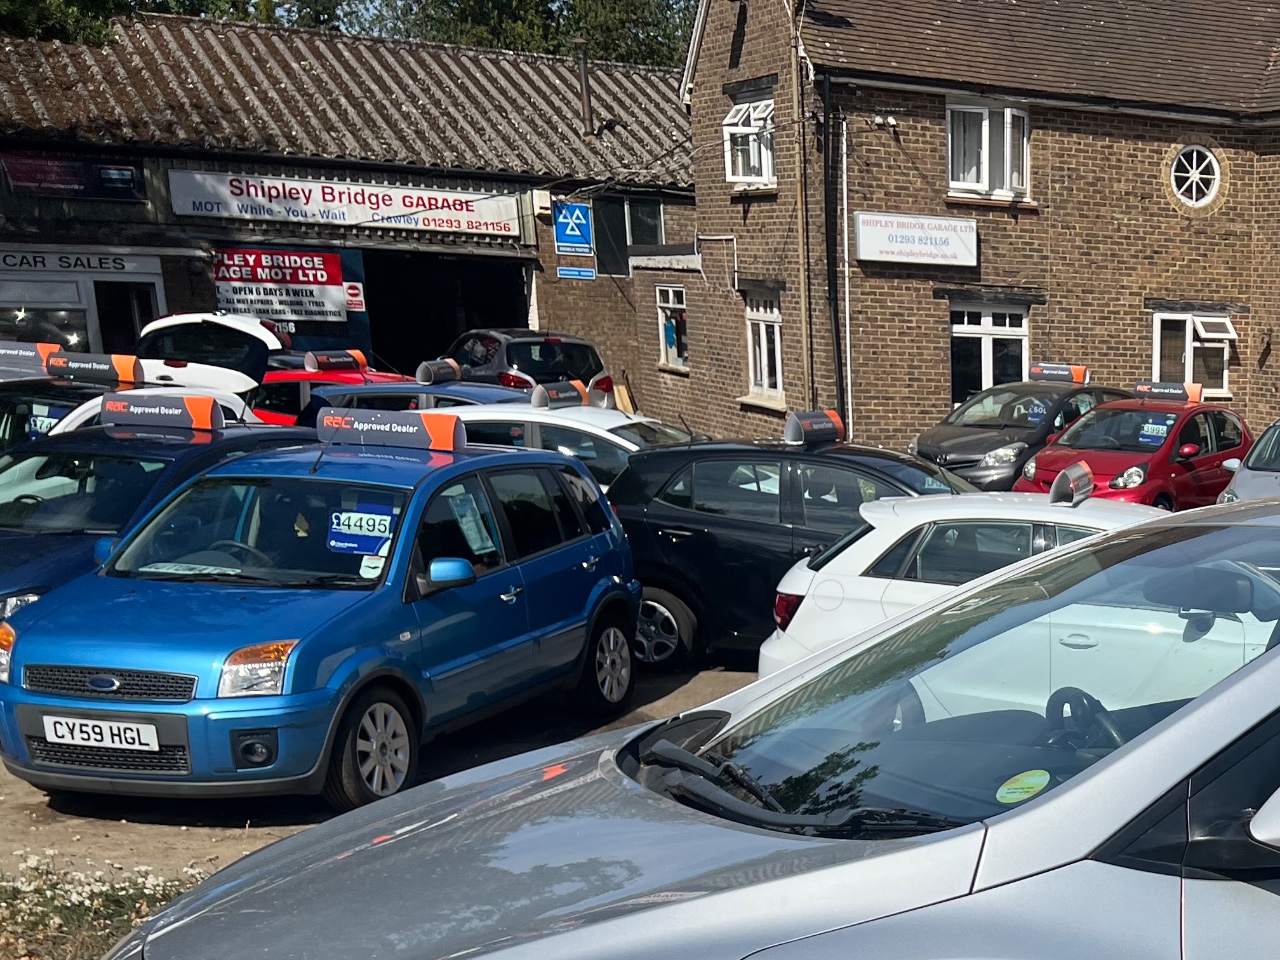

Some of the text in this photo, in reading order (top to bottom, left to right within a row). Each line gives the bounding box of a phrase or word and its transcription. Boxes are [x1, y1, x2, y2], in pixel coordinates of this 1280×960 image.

[229, 178, 475, 212] Shipley Bridge GARAGE
[192, 201, 346, 221] MOT While You Wait
[371, 212, 419, 227] Crawley
[422, 218, 511, 232] 01293 821156
[861, 219, 974, 233] SHIPLEY BRIDGE GARAGE LTD
[888, 234, 950, 246] 01293 821156
[261, 254, 324, 268] BRIDGE
[879, 249, 958, 259] www.shipleybridge.co.uk
[2, 254, 126, 270] CAR SALES
[218, 266, 328, 282] AGE MOT LTD
[232, 286, 254, 295] OPEN
[263, 287, 283, 297] DAYS
[285, 288, 291, 297] A
[291, 288, 315, 297] WEEK
[105, 401, 182, 415] RAC Approved Dealer
[323, 416, 419, 433] RAC Approved Dealer
[331, 512, 388, 534] £4495
[53, 720, 150, 747] CY59 HGL
